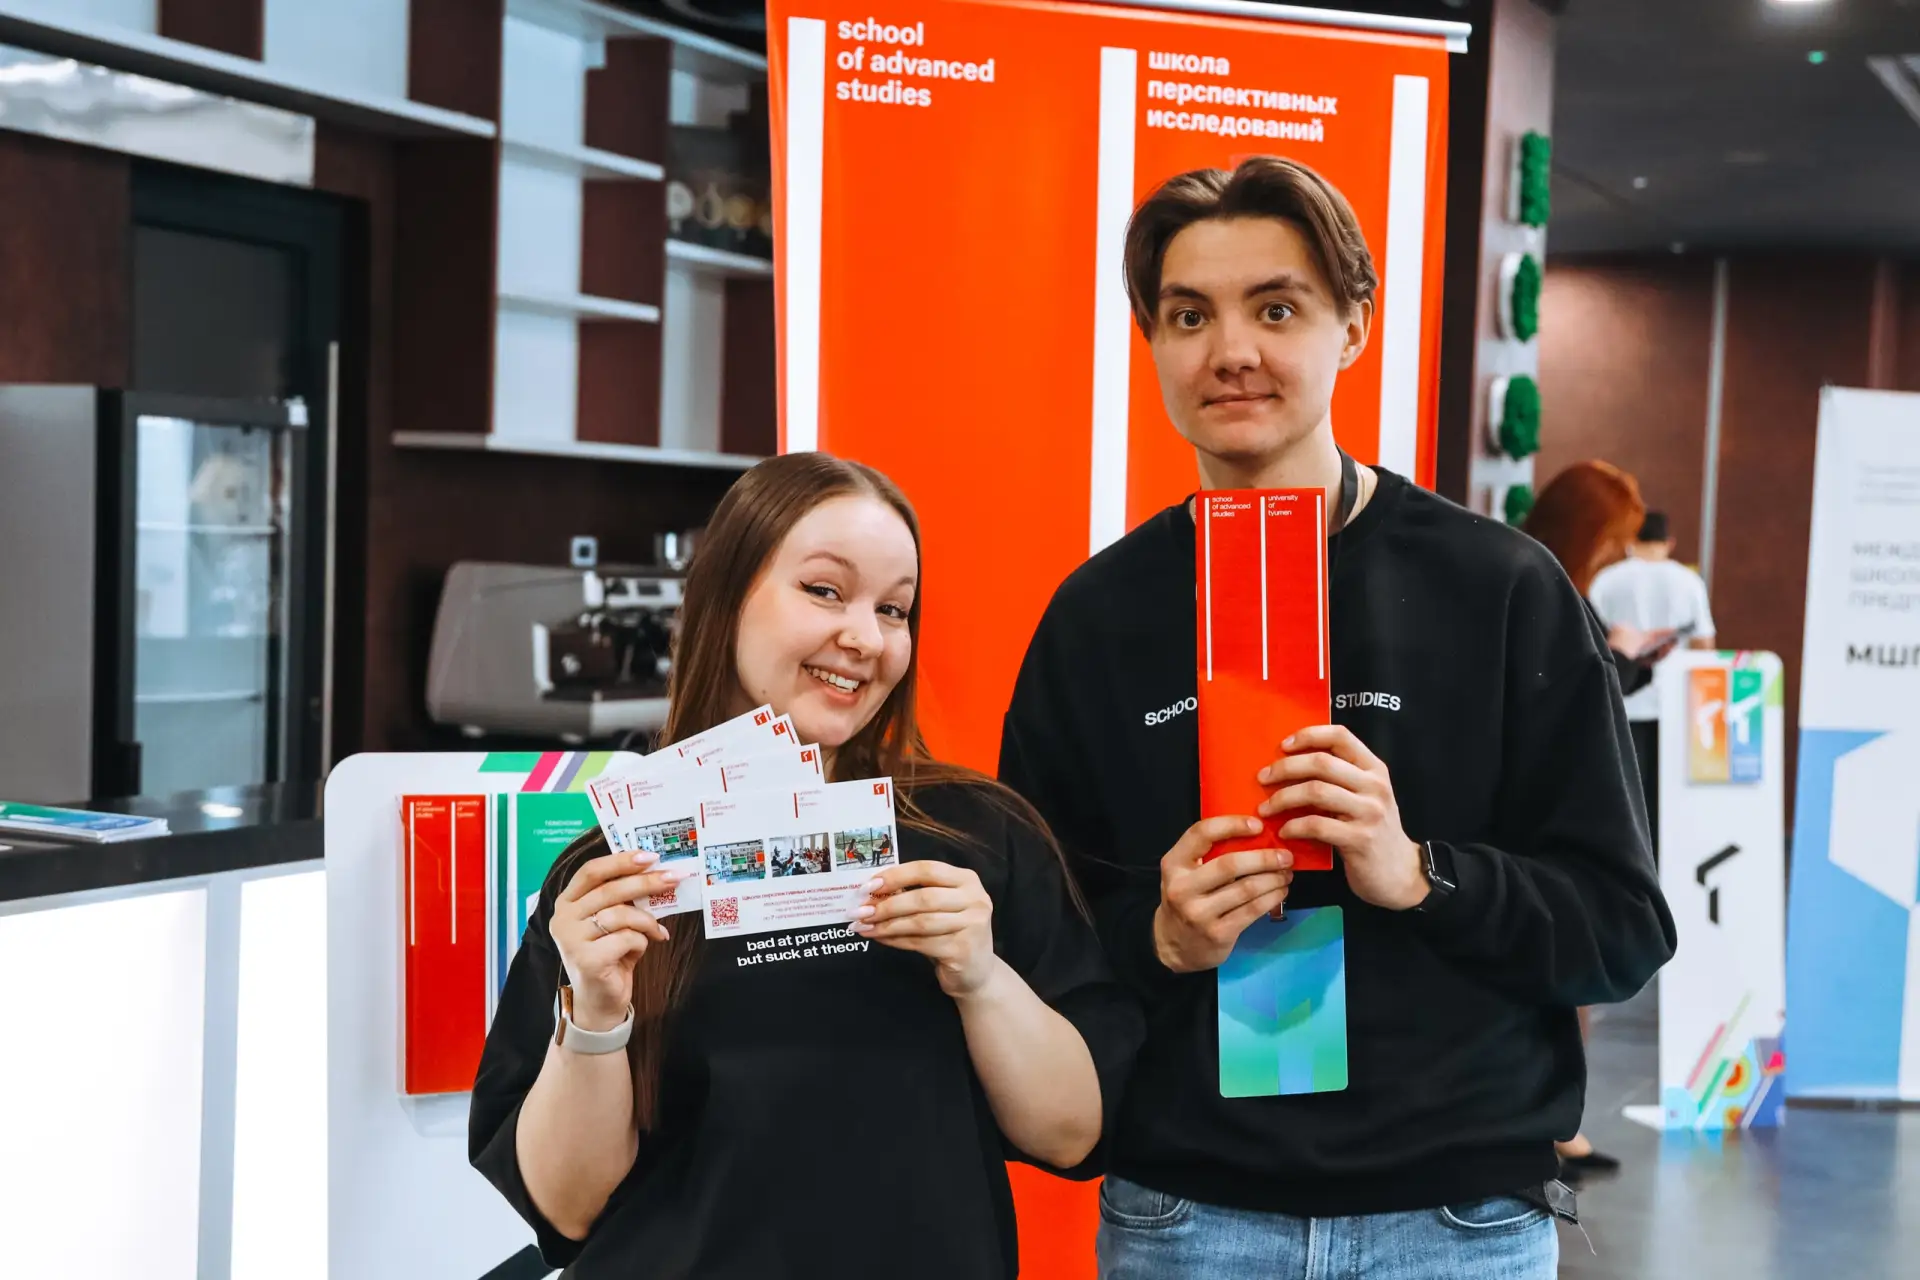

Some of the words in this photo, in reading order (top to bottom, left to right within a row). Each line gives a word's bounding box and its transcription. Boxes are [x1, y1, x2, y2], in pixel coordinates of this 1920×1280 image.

[838, 16, 924, 46] school
[836, 46, 865, 71] of
[870, 50, 995, 83] advanced
[1148, 51, 1230, 76] школа
[836, 78, 932, 107] studies
[1147, 80, 1337, 115] перспективных
[1146, 109, 1324, 142] исследований
[1219, 502, 1251, 510] advanced
[1144, 696, 1198, 726] SCHOO
[1335, 691, 1402, 711] STUDIES
[737, 955, 763, 967] but
[765, 949, 801, 962] suck
[803, 946, 819, 958] at
[821, 941, 870, 955] theory
[746, 937, 775, 951] bad
[778, 934, 793, 947] at
[795, 928, 855, 946] practice
